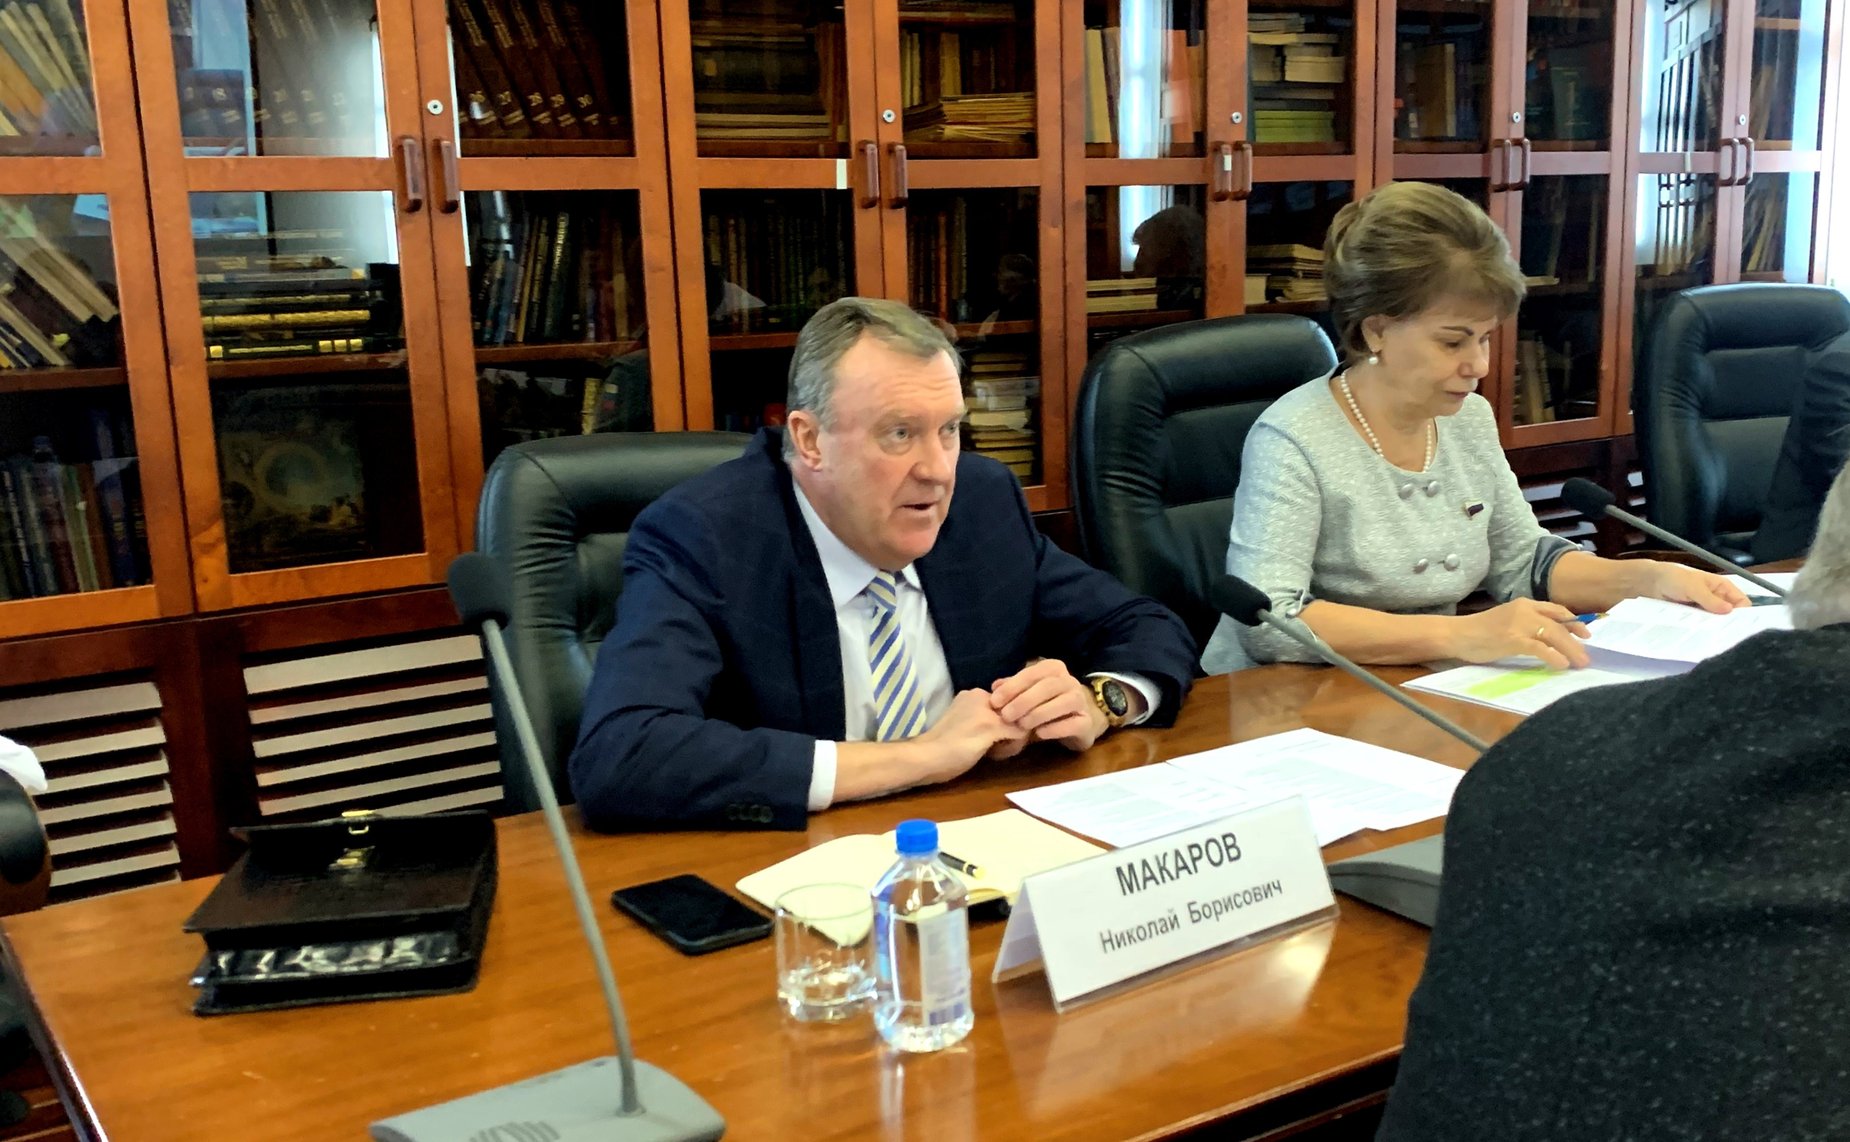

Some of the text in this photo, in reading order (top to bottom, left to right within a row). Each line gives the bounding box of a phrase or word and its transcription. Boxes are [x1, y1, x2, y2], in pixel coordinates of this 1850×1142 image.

[1115, 833, 1242, 896] МАКАРОВ
[1100, 879, 1283, 953] Николай Борисович
